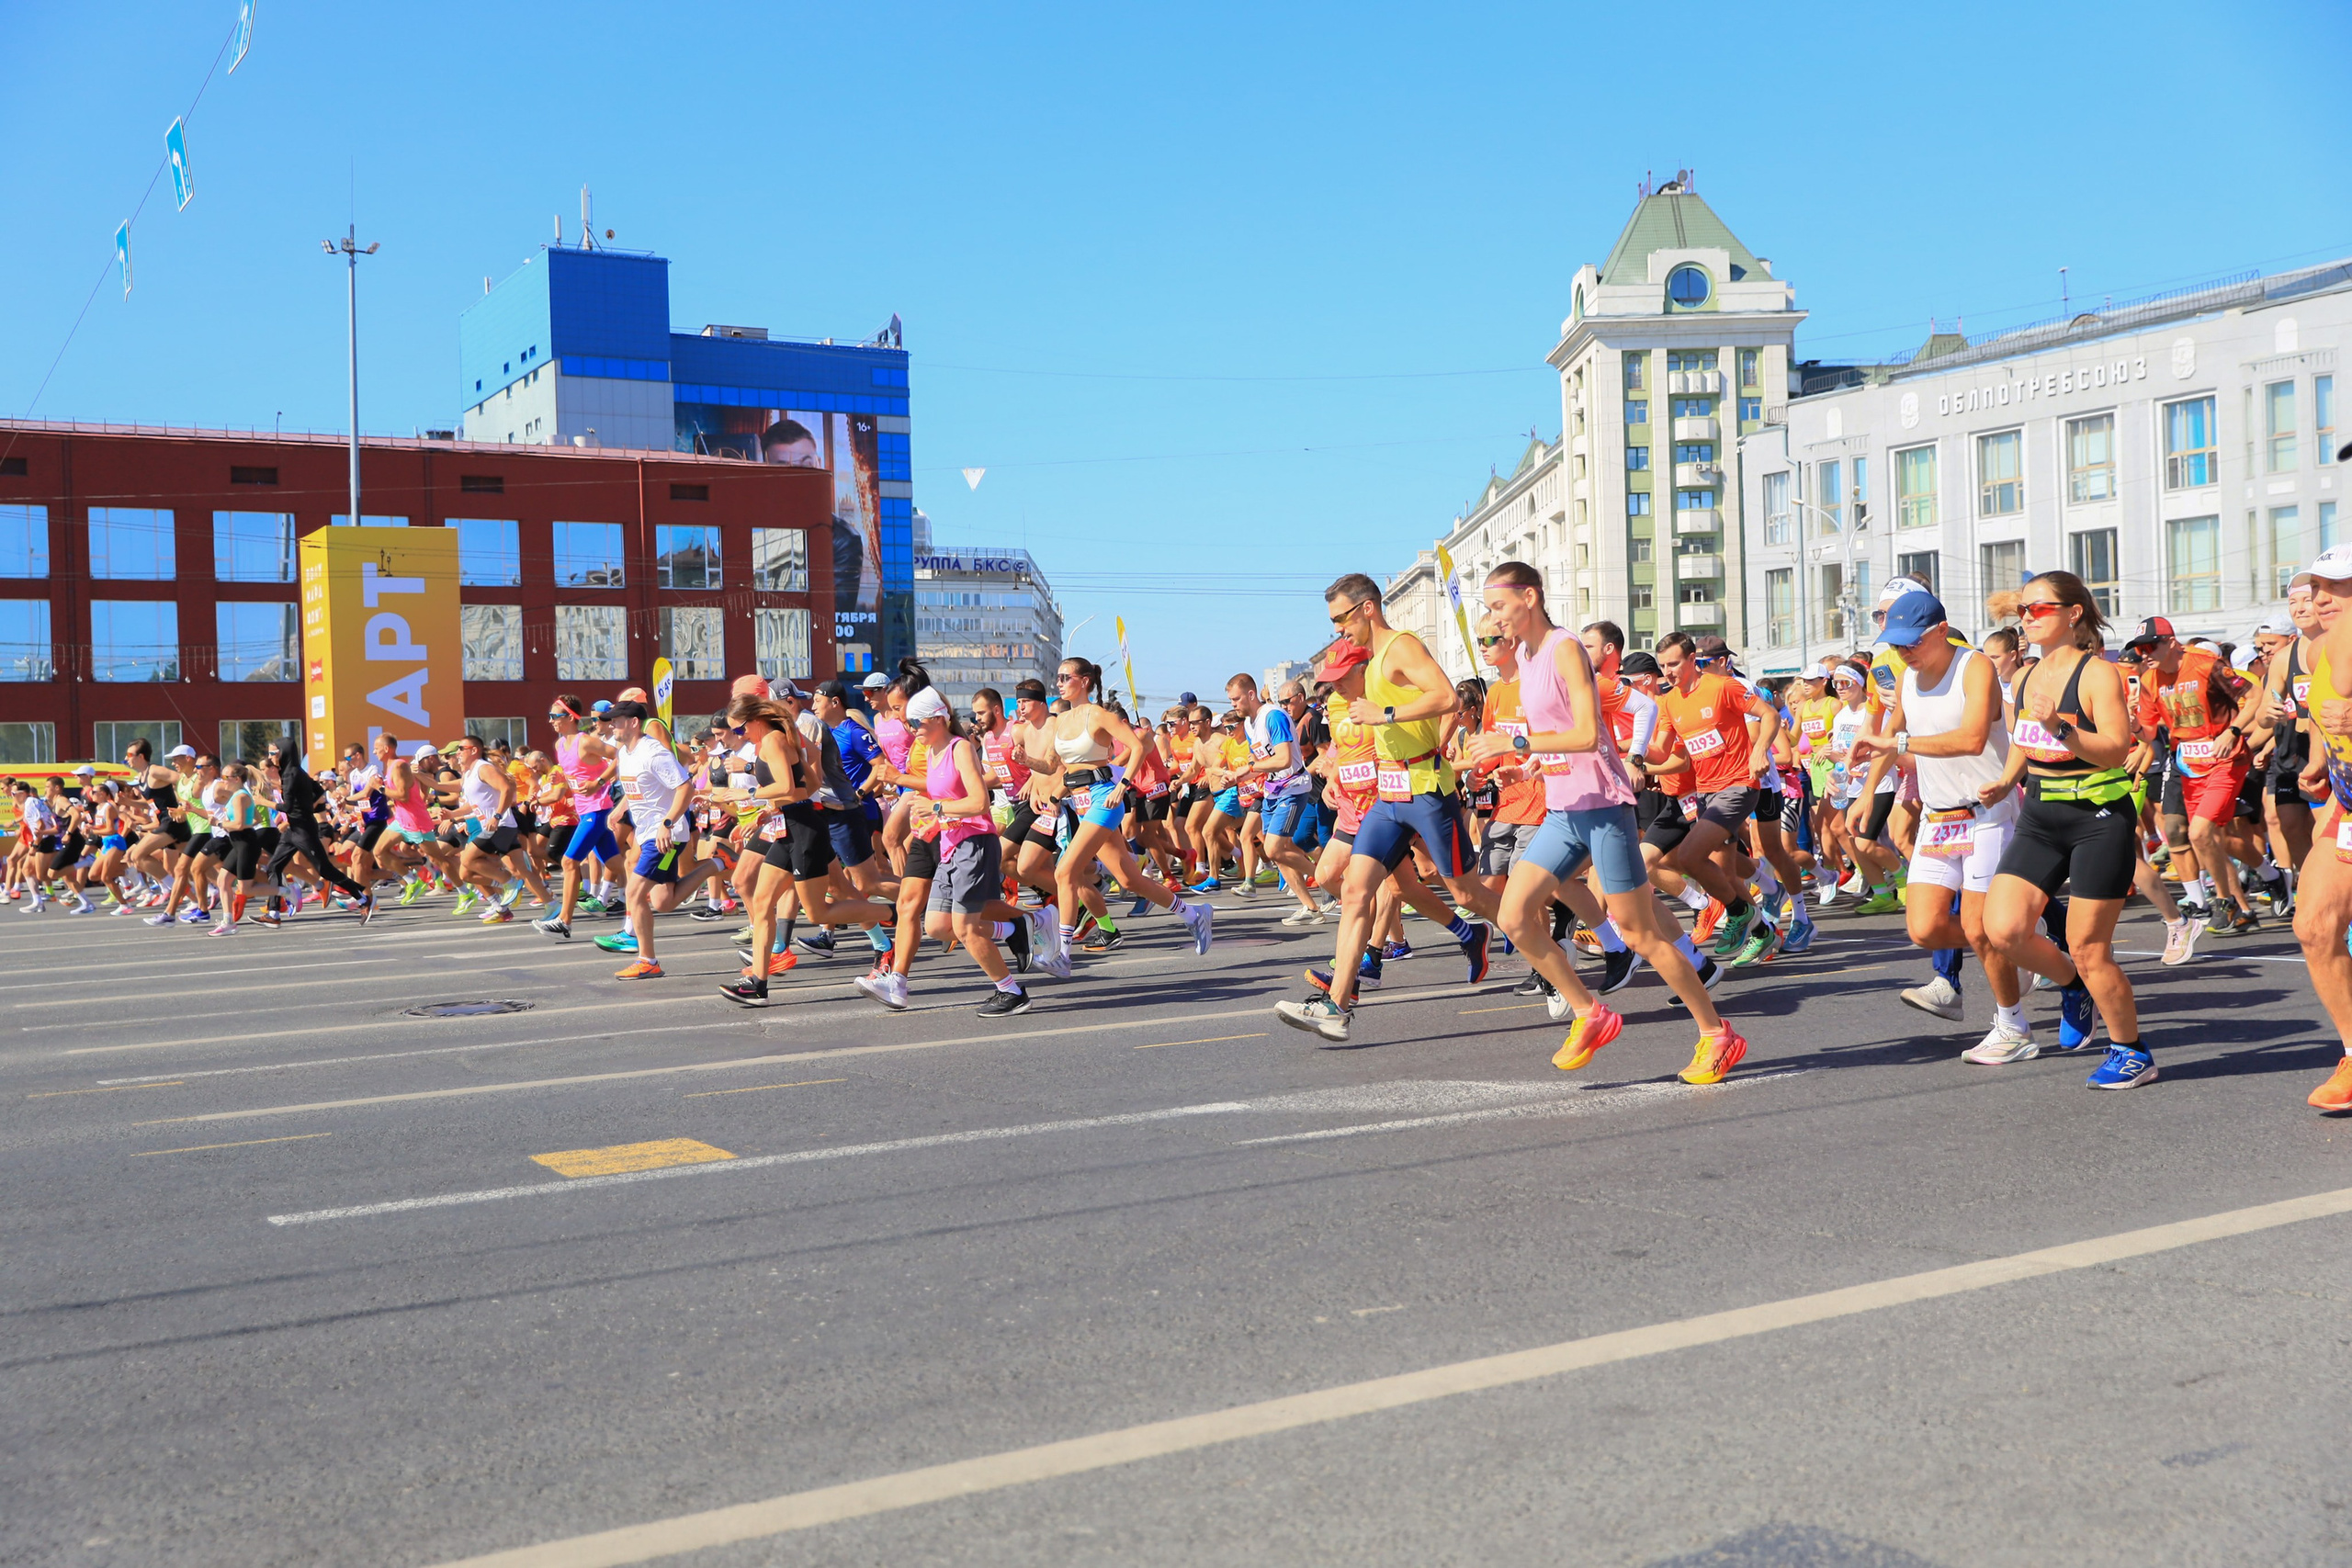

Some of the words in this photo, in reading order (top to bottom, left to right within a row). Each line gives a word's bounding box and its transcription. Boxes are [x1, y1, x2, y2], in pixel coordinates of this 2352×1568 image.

[1939, 356, 2147, 416] ОБЛПОТРЕБСОЮЗ
[857, 422, 871, 432] 16+
[974, 558, 1009, 571] БКС
[1700, 706, 1713, 720] 10
[1803, 721, 1821, 732] 2342
[1688, 734, 1716, 752] 2193
[2018, 724, 2061, 746] 184
[2183, 744, 2210, 755] 1730
[1341, 765, 1371, 781] 1340
[1380, 773, 1403, 789] 1521
[1929, 823, 1968, 842] 2371
